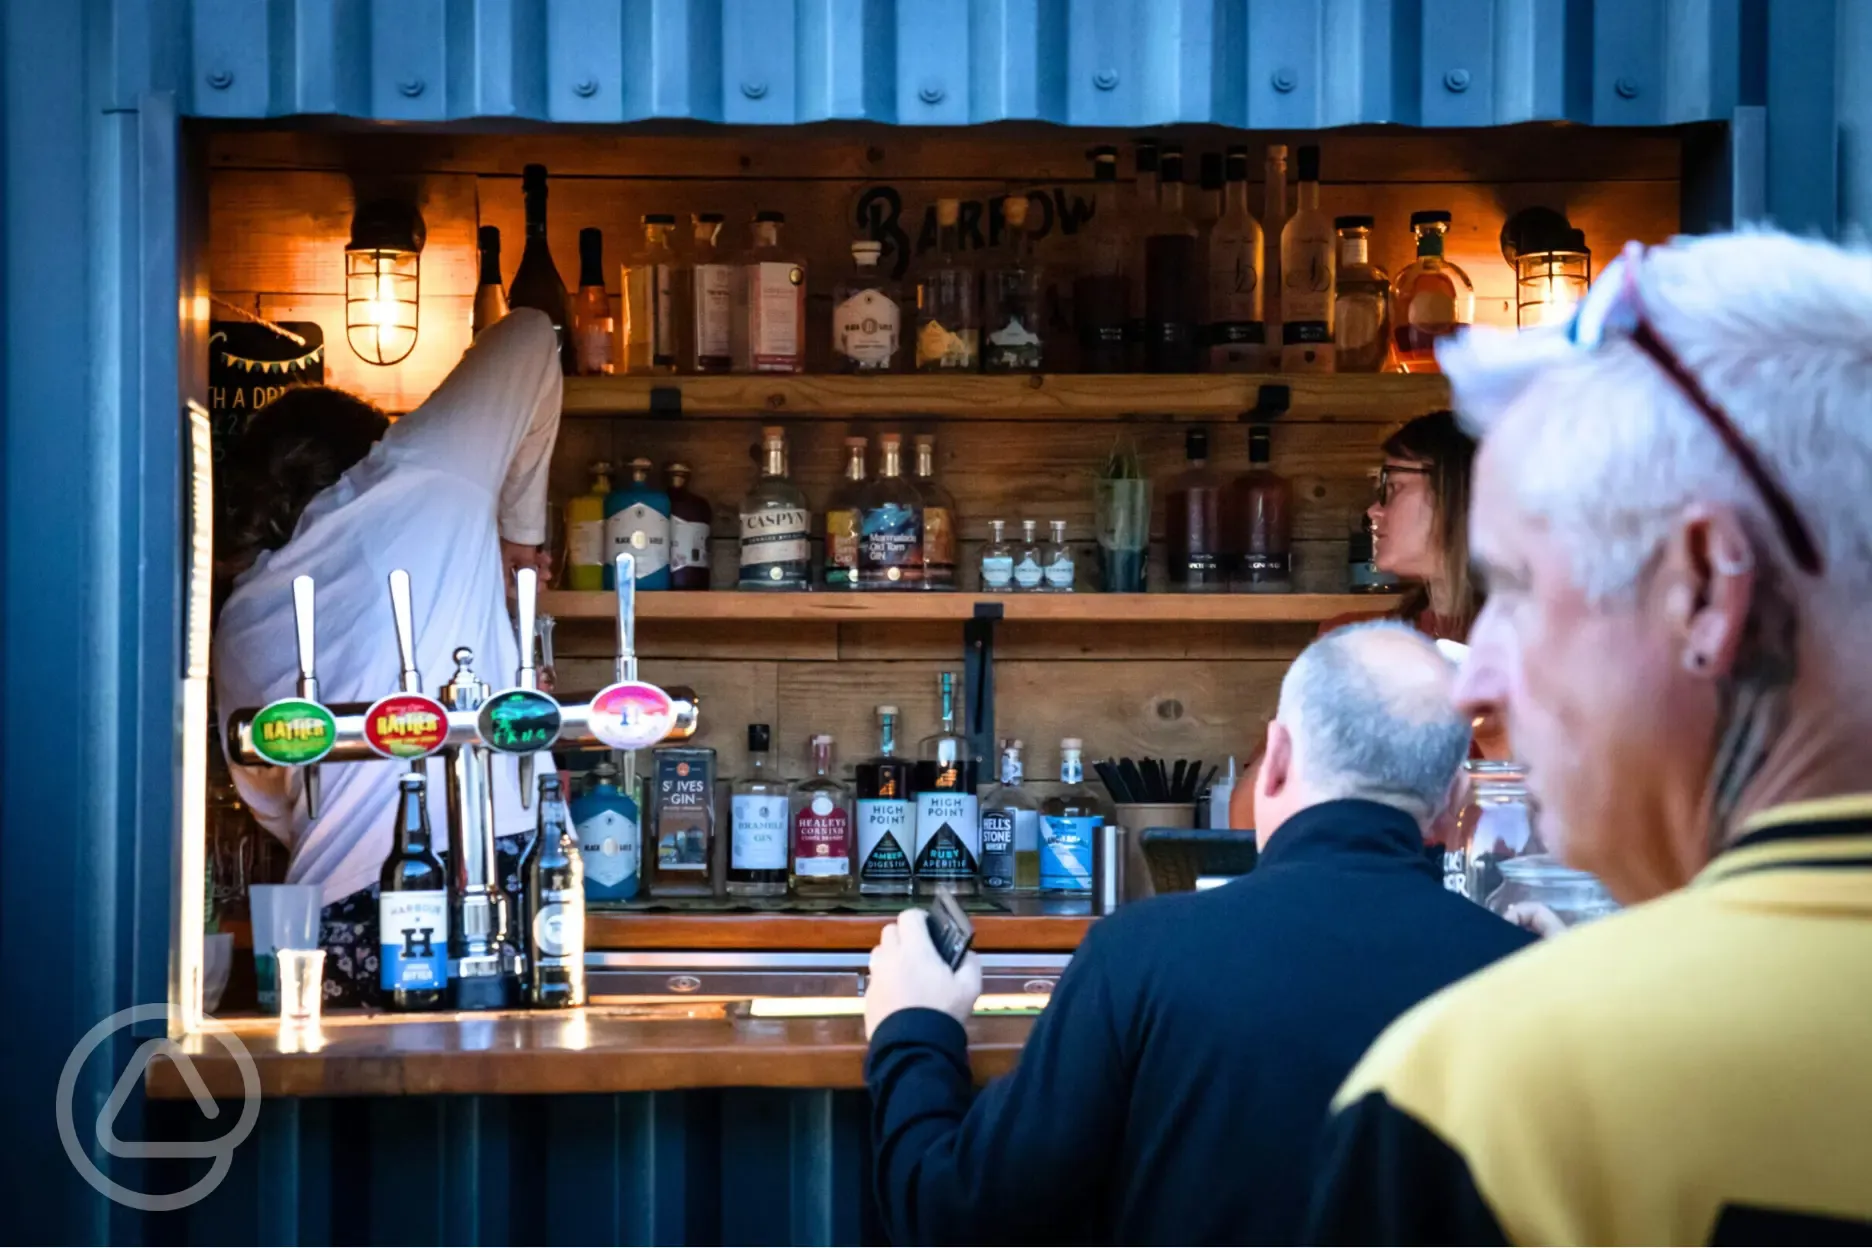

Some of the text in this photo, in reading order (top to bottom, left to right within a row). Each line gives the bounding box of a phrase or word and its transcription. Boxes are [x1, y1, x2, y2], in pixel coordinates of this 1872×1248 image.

[747, 511, 804, 529] CASPYN
[869, 543, 905, 551] Old Tom
[869, 552, 886, 560] GIN
[677, 780, 704, 792] IVES
[671, 793, 696, 805] GIN
[931, 797, 962, 807] HIGH
[873, 805, 904, 815] HIGH
[927, 807, 964, 817] POINT
[870, 815, 905, 825] POINT
[983, 818, 1012, 831] HELL'S
[801, 827, 844, 836] CORNISH
[753, 834, 773, 842] GIN
[983, 831, 1012, 843] STONE
[872, 851, 903, 860] AMBER
[930, 849, 959, 859] RUBY
[923, 859, 967, 868] APERITIF
[400, 927, 435, 958] H
